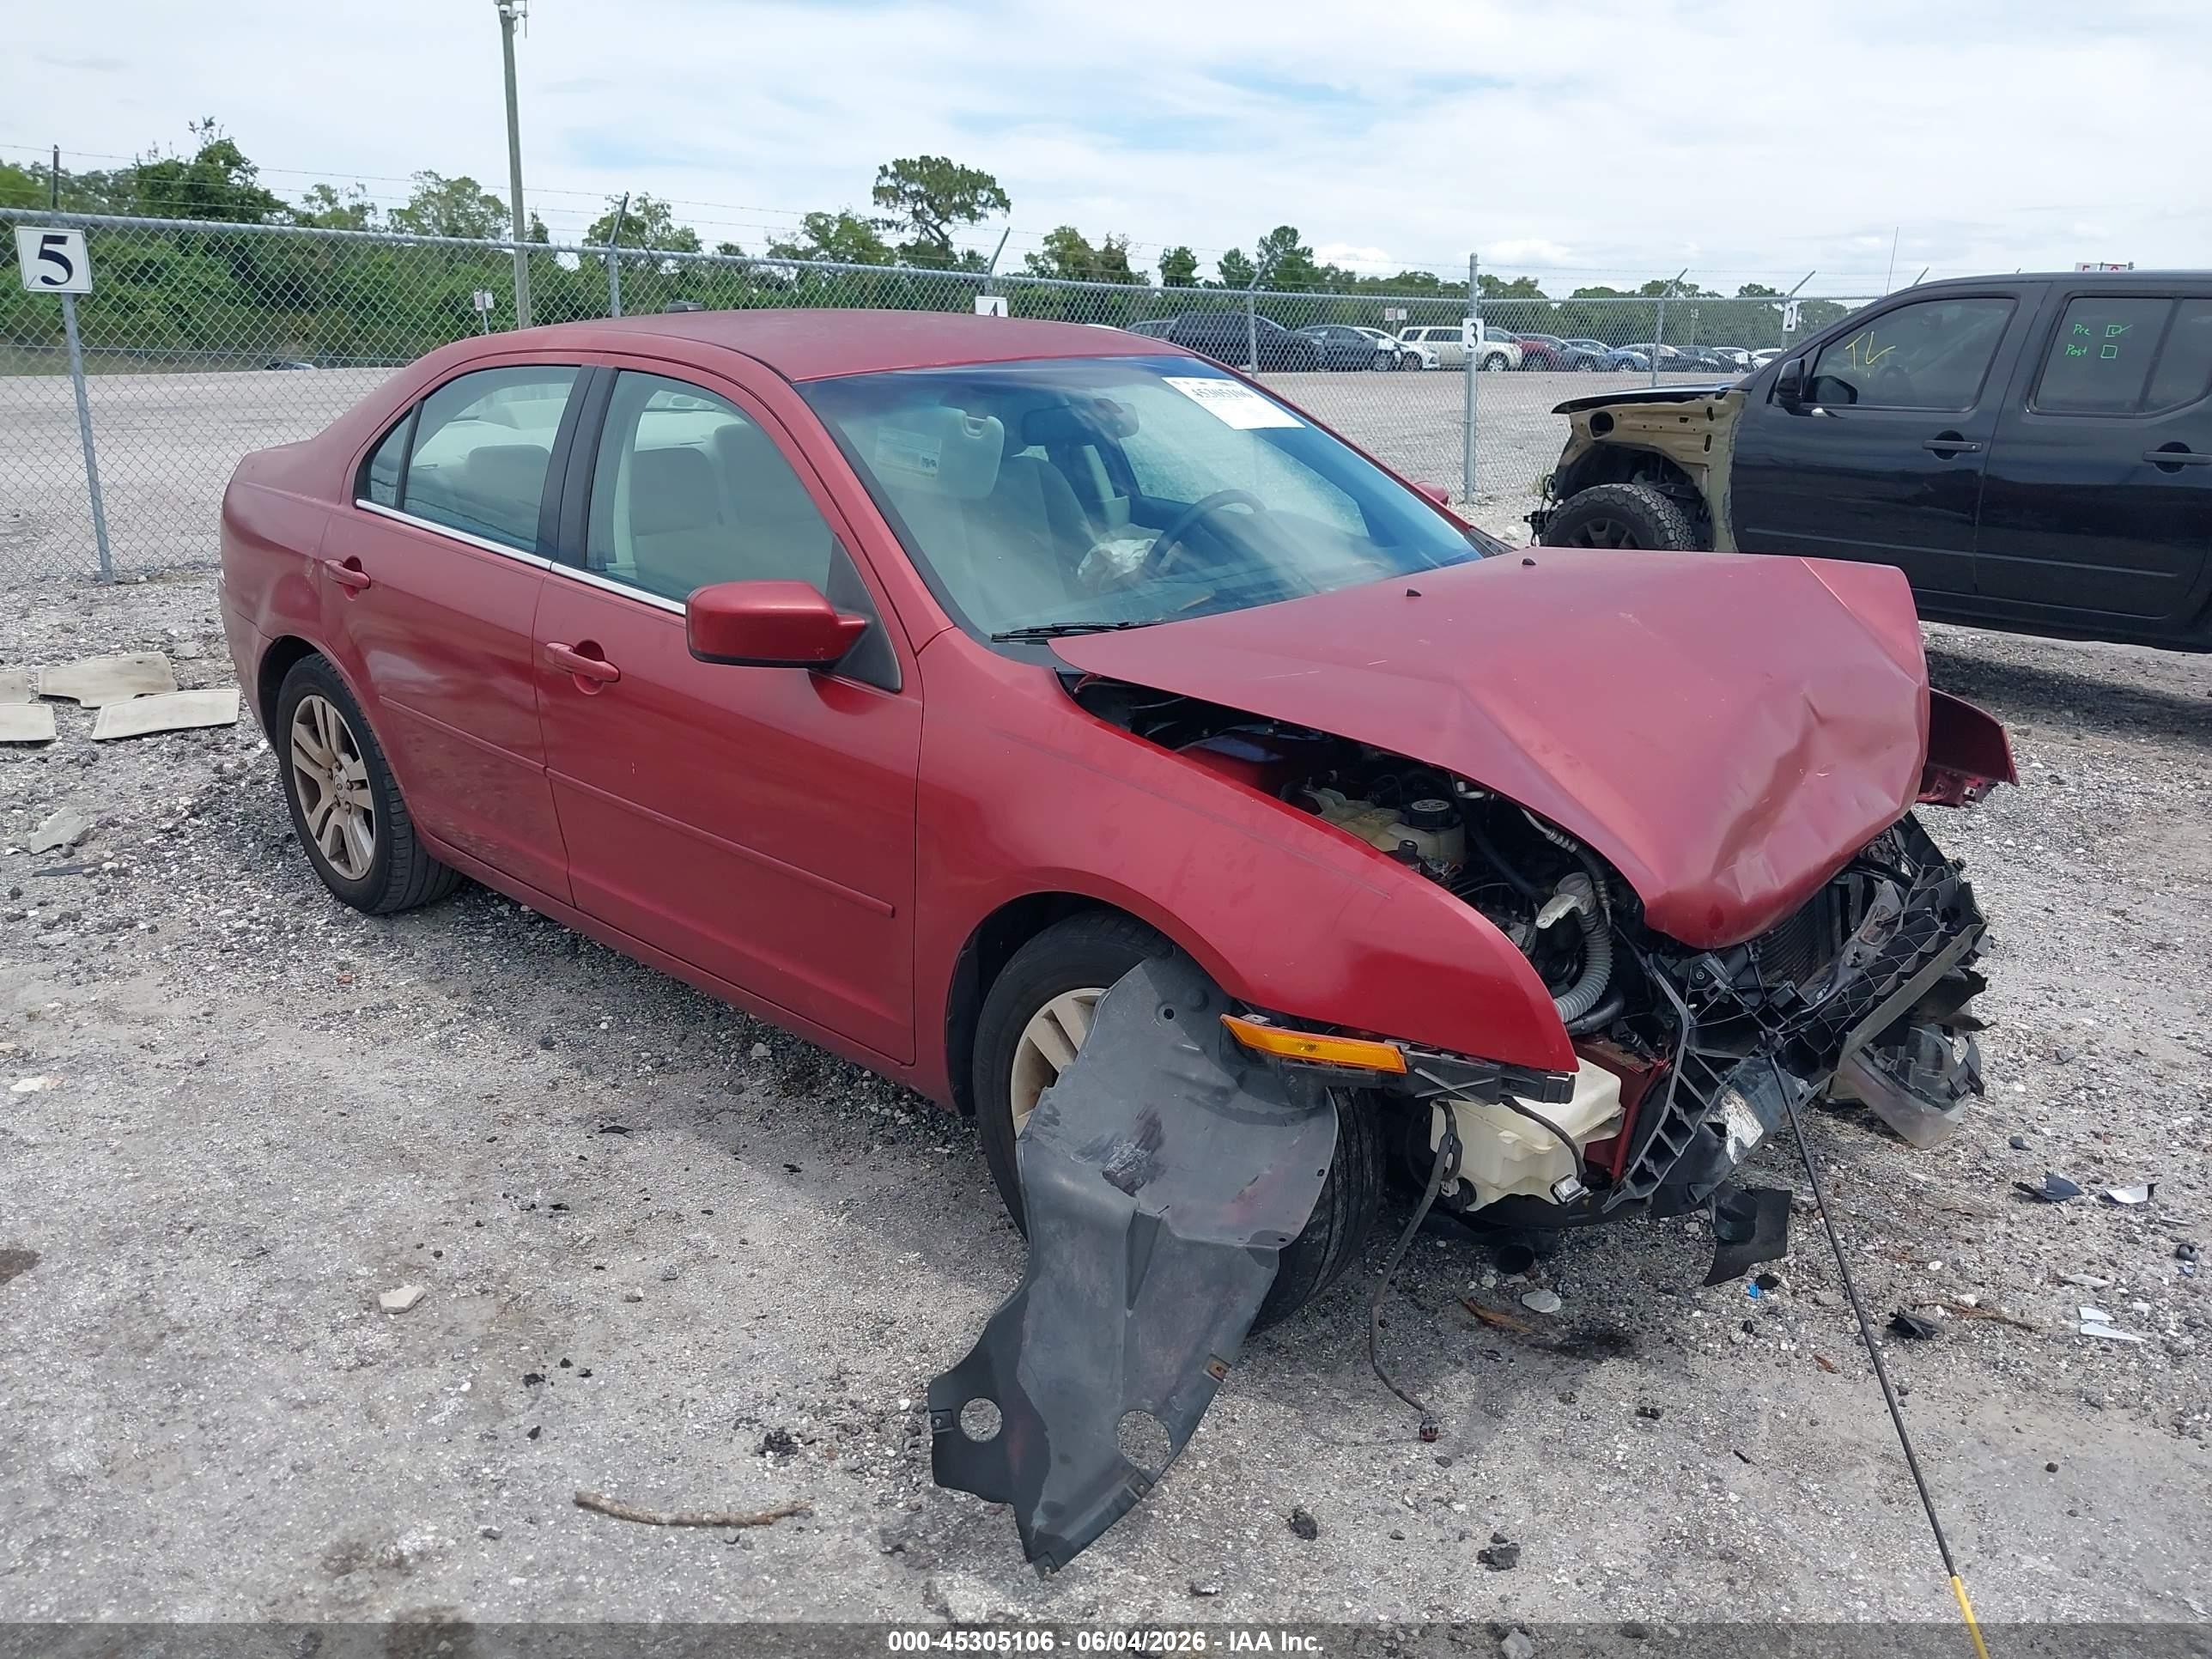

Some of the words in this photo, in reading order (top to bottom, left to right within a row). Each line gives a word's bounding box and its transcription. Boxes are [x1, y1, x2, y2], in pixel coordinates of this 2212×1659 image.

[38, 234, 74, 286] 5
[1785, 306, 1794, 329] 2
[1467, 322, 1478, 349] 3
[2073, 324, 2091, 337] Pre
[2065, 343, 2088, 357] Post
